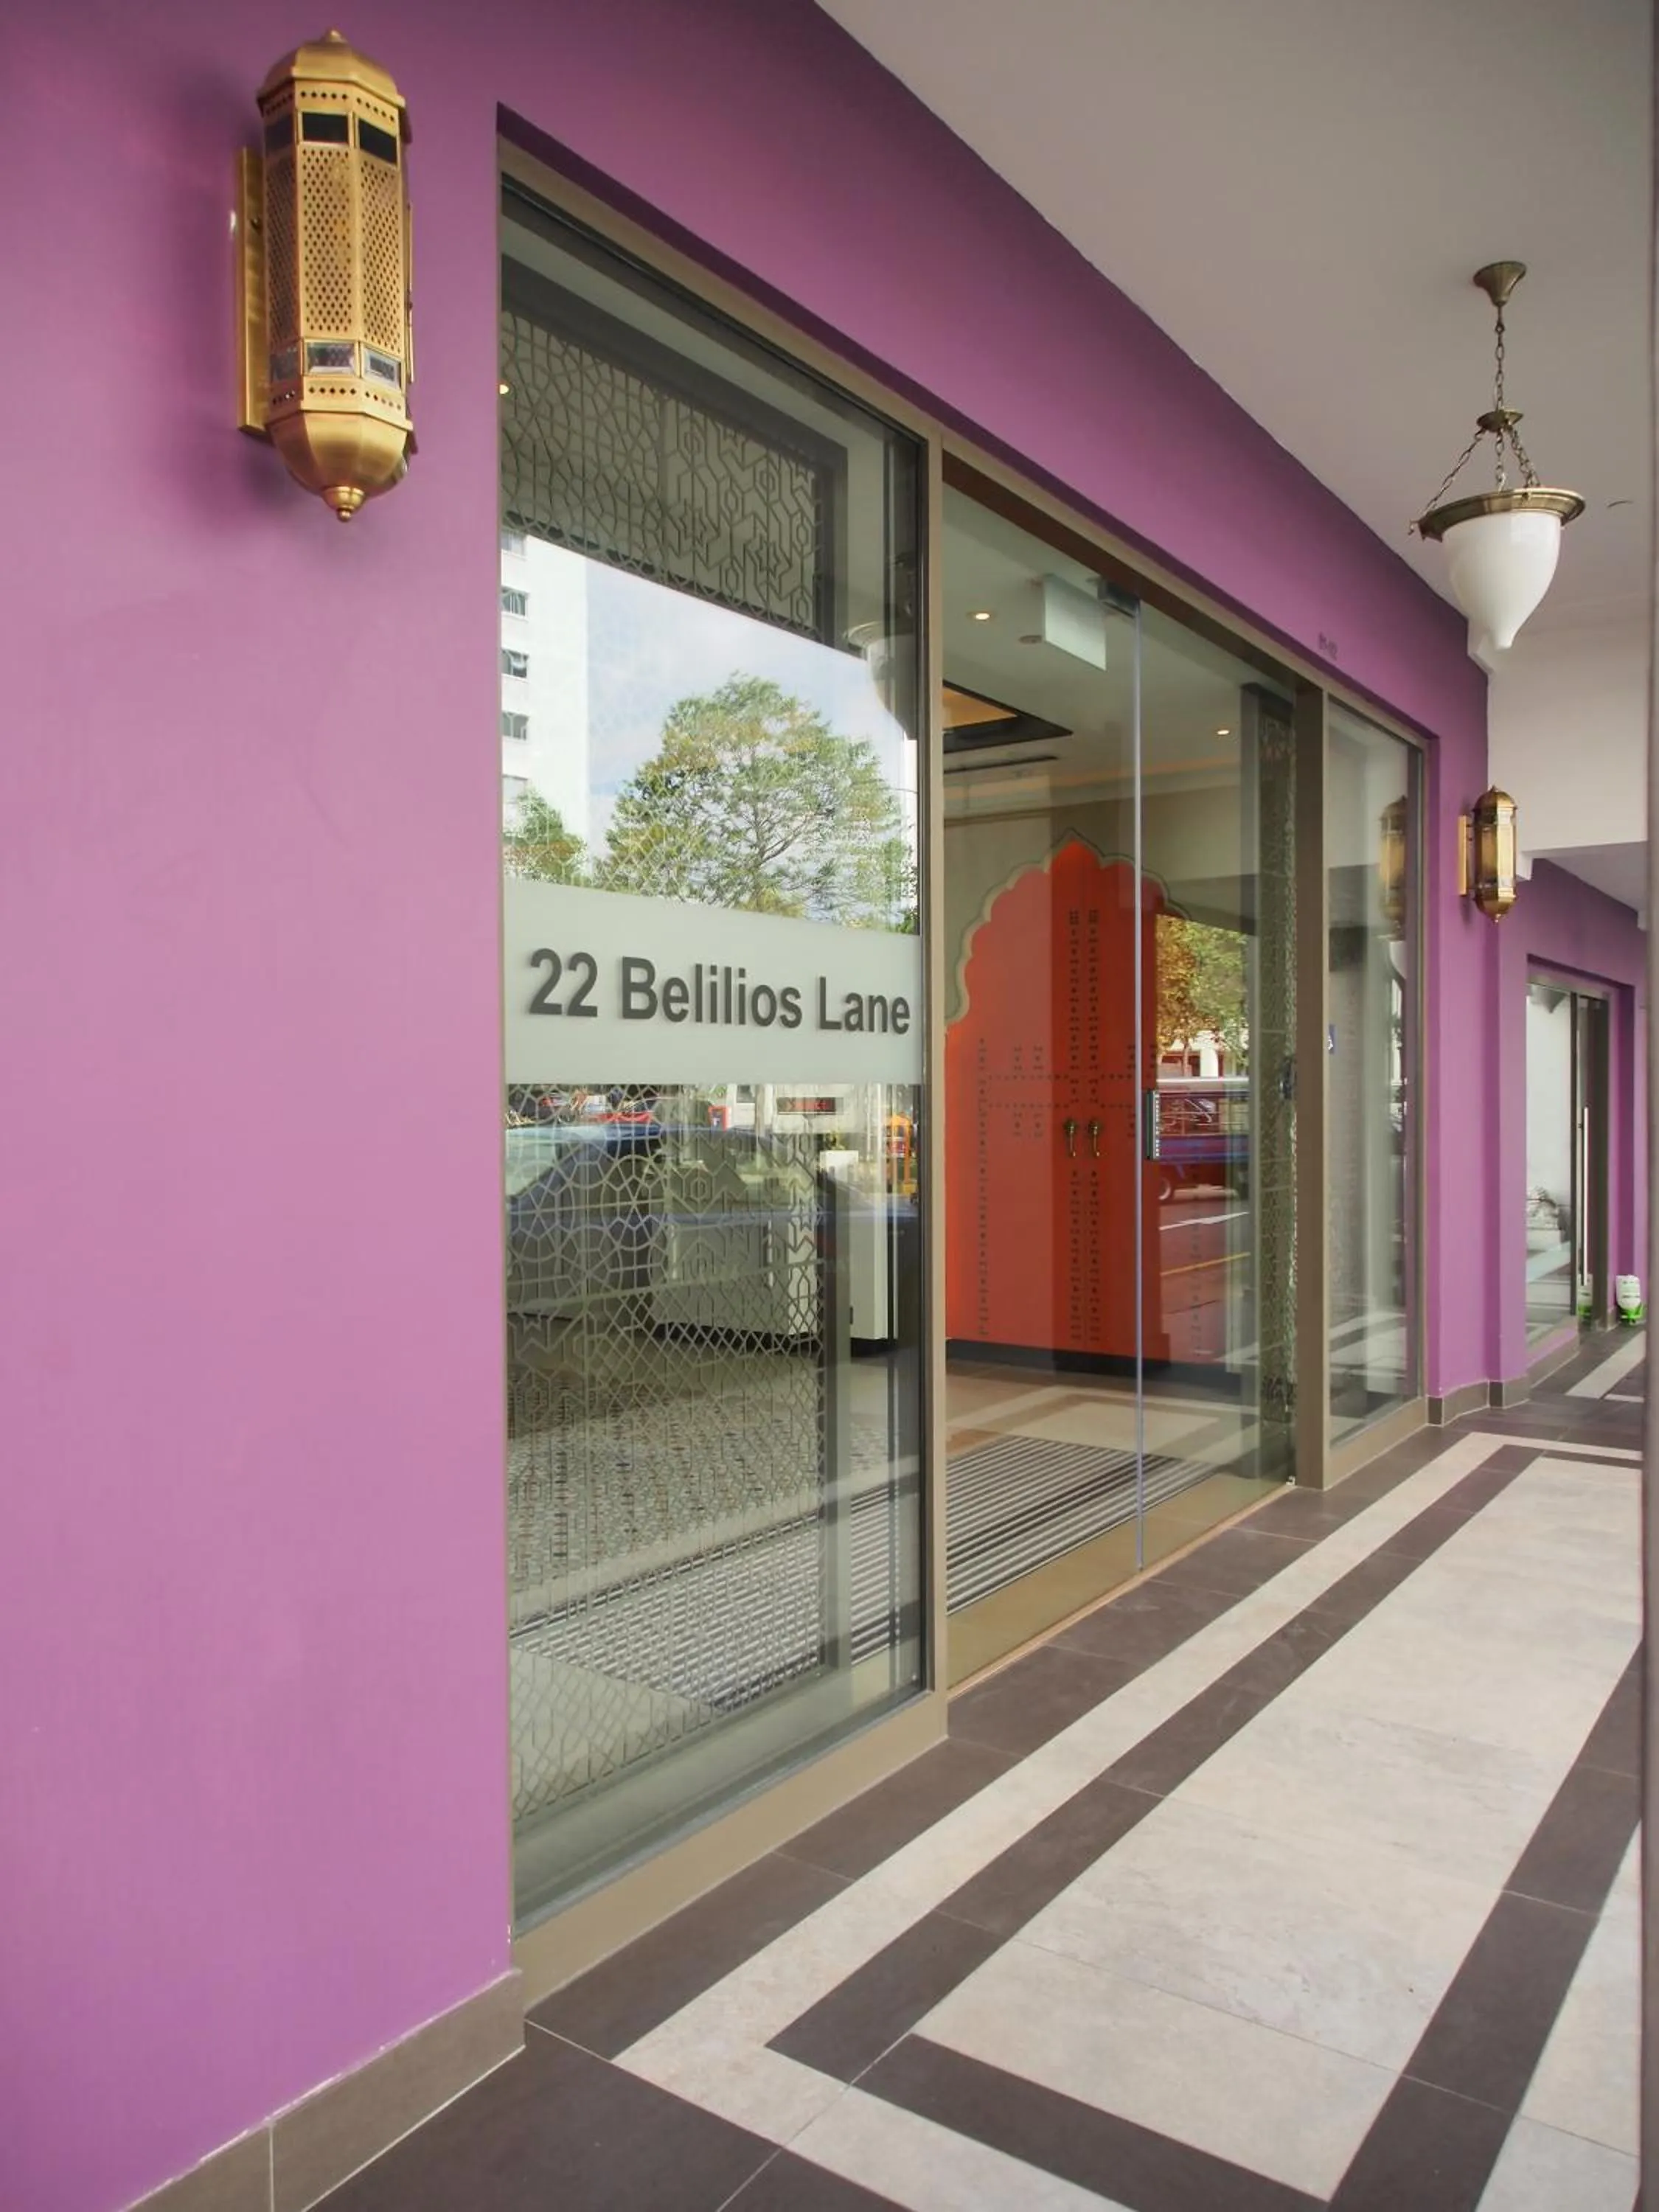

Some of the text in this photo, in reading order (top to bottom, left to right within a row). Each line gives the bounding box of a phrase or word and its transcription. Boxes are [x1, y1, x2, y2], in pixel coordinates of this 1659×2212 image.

[527, 947, 911, 1035] 22 Belilios Lane
